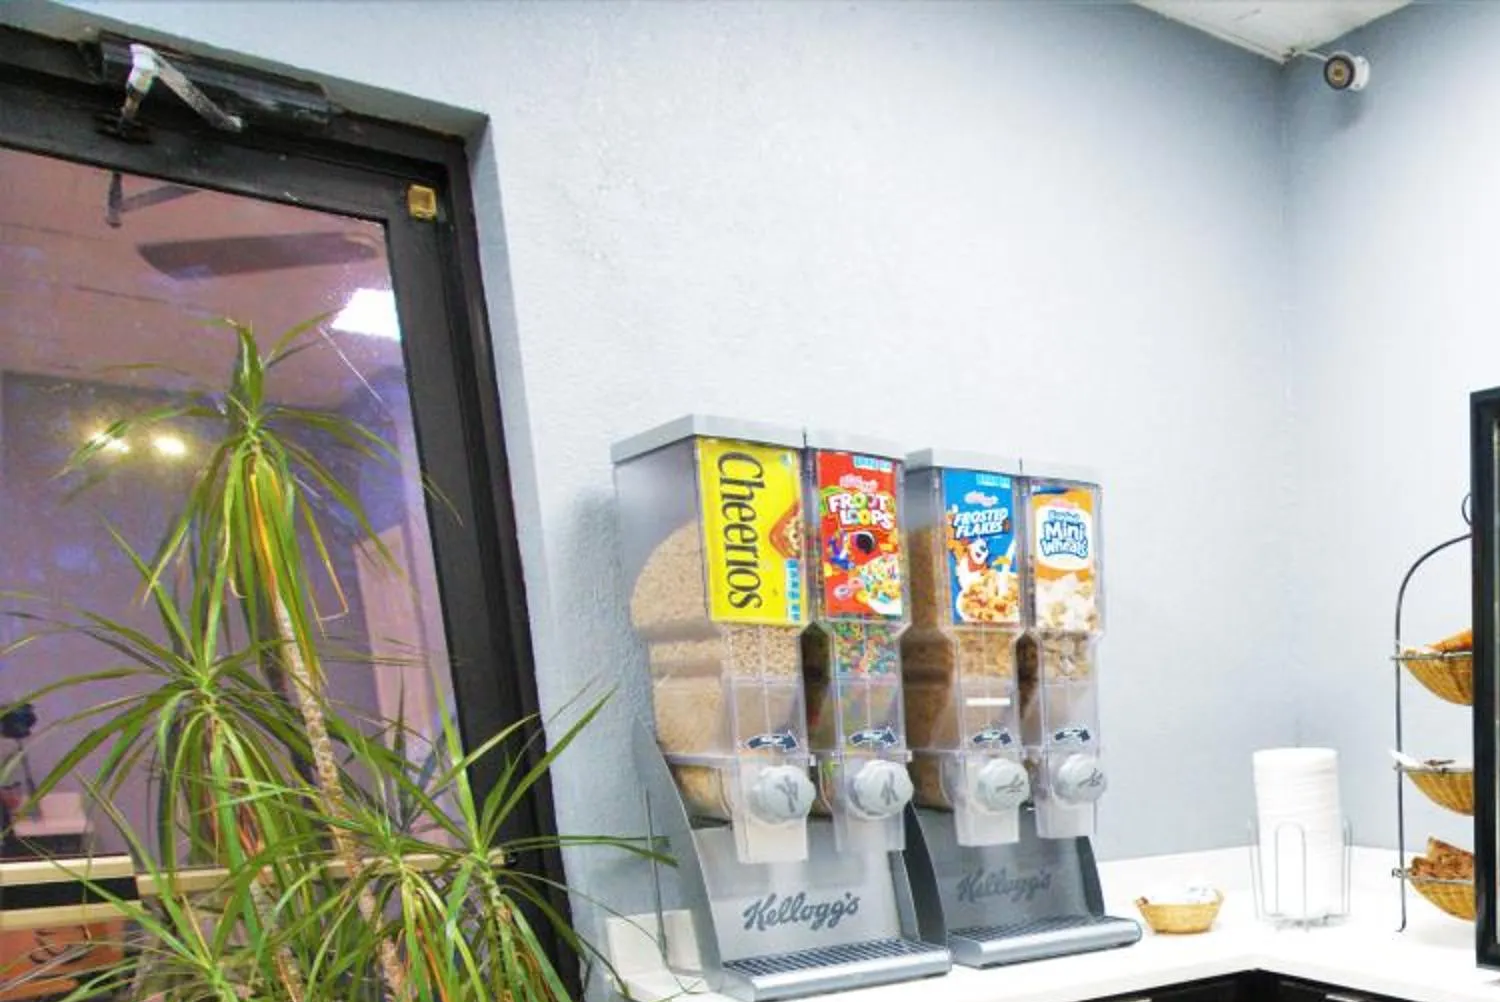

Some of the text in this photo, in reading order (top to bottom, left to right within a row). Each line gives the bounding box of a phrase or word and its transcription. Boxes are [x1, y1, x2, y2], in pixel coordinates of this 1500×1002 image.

[827, 492, 890, 513] FROOT
[840, 509, 894, 530] LOOPS
[953, 507, 1008, 527] FROSTED
[718, 452, 764, 609] Cheerios
[956, 520, 1003, 539] FLAKES
[1043, 520, 1086, 541] Mini
[956, 867, 1051, 903] Kellogg's
[742, 891, 861, 932] Kellogg's
